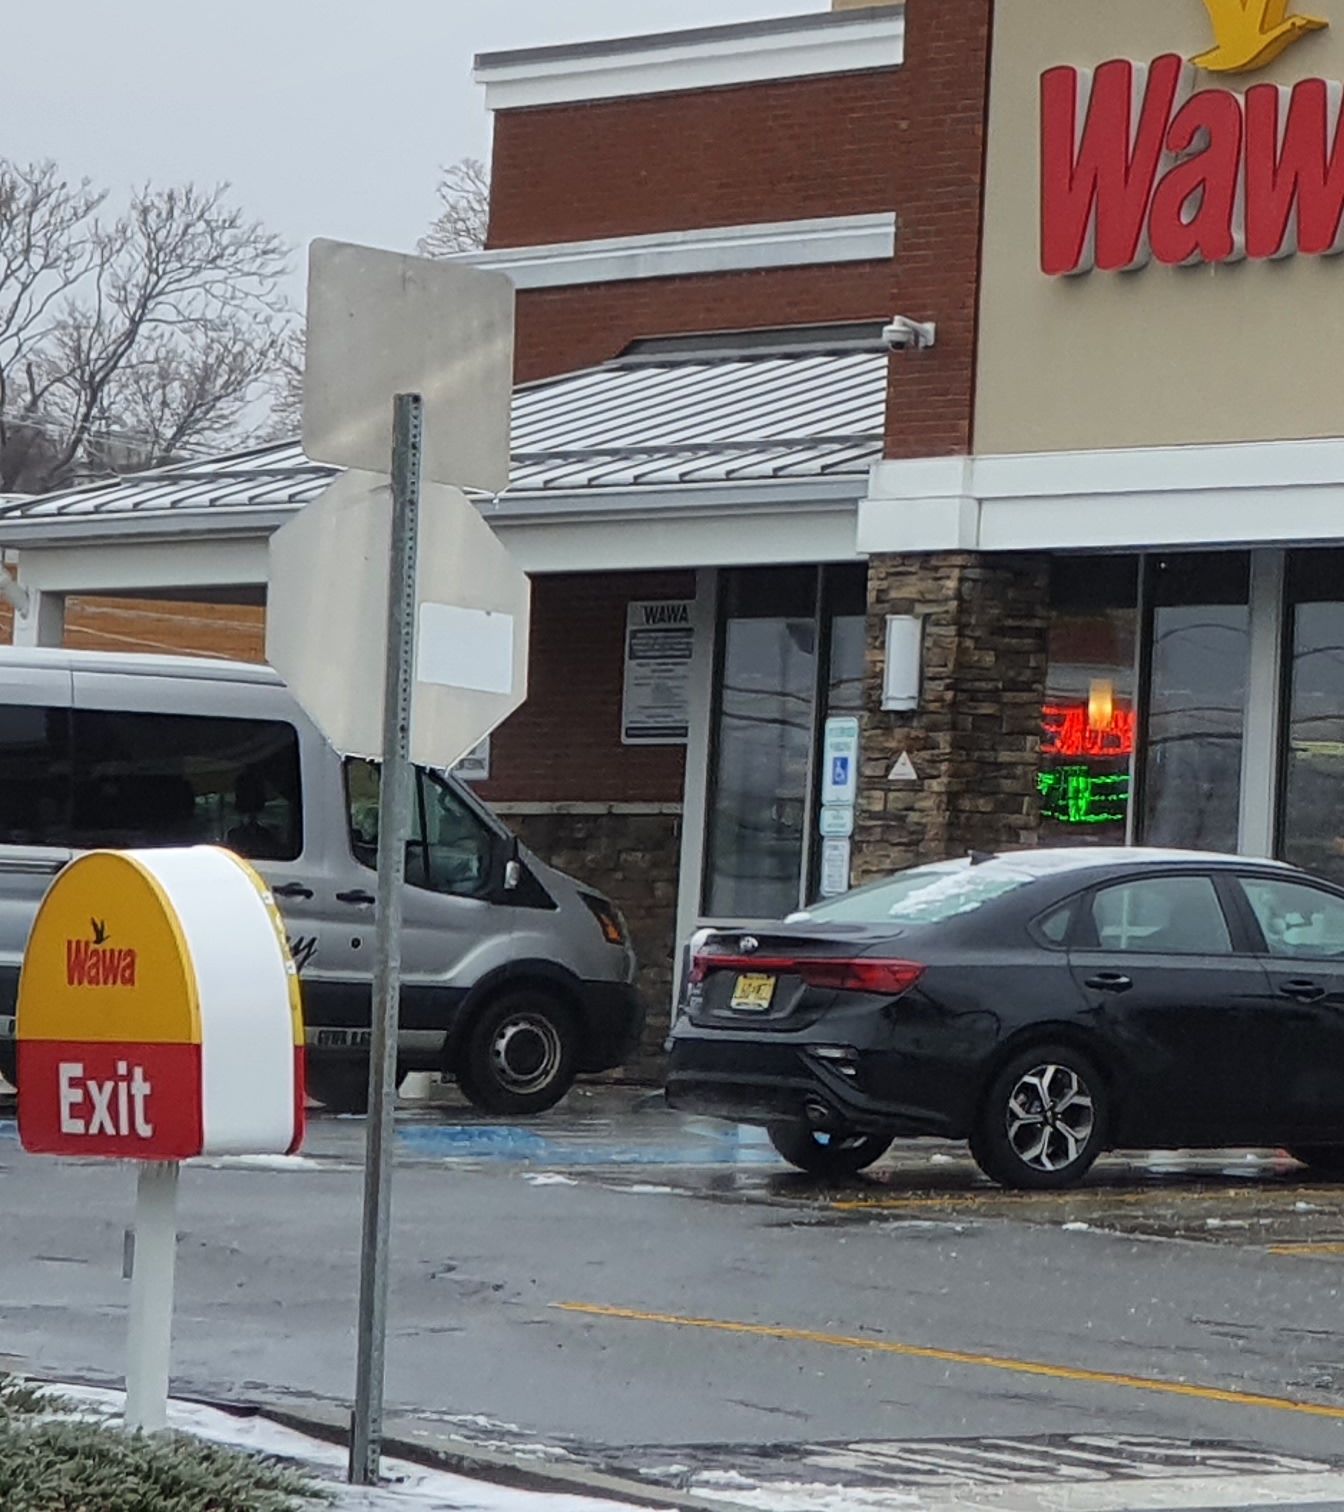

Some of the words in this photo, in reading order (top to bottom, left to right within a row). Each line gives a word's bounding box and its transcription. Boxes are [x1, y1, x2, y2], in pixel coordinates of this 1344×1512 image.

[643, 604, 691, 625] WAWA
[66, 939, 137, 987] Wawa
[58, 1059, 153, 1139] Exit
